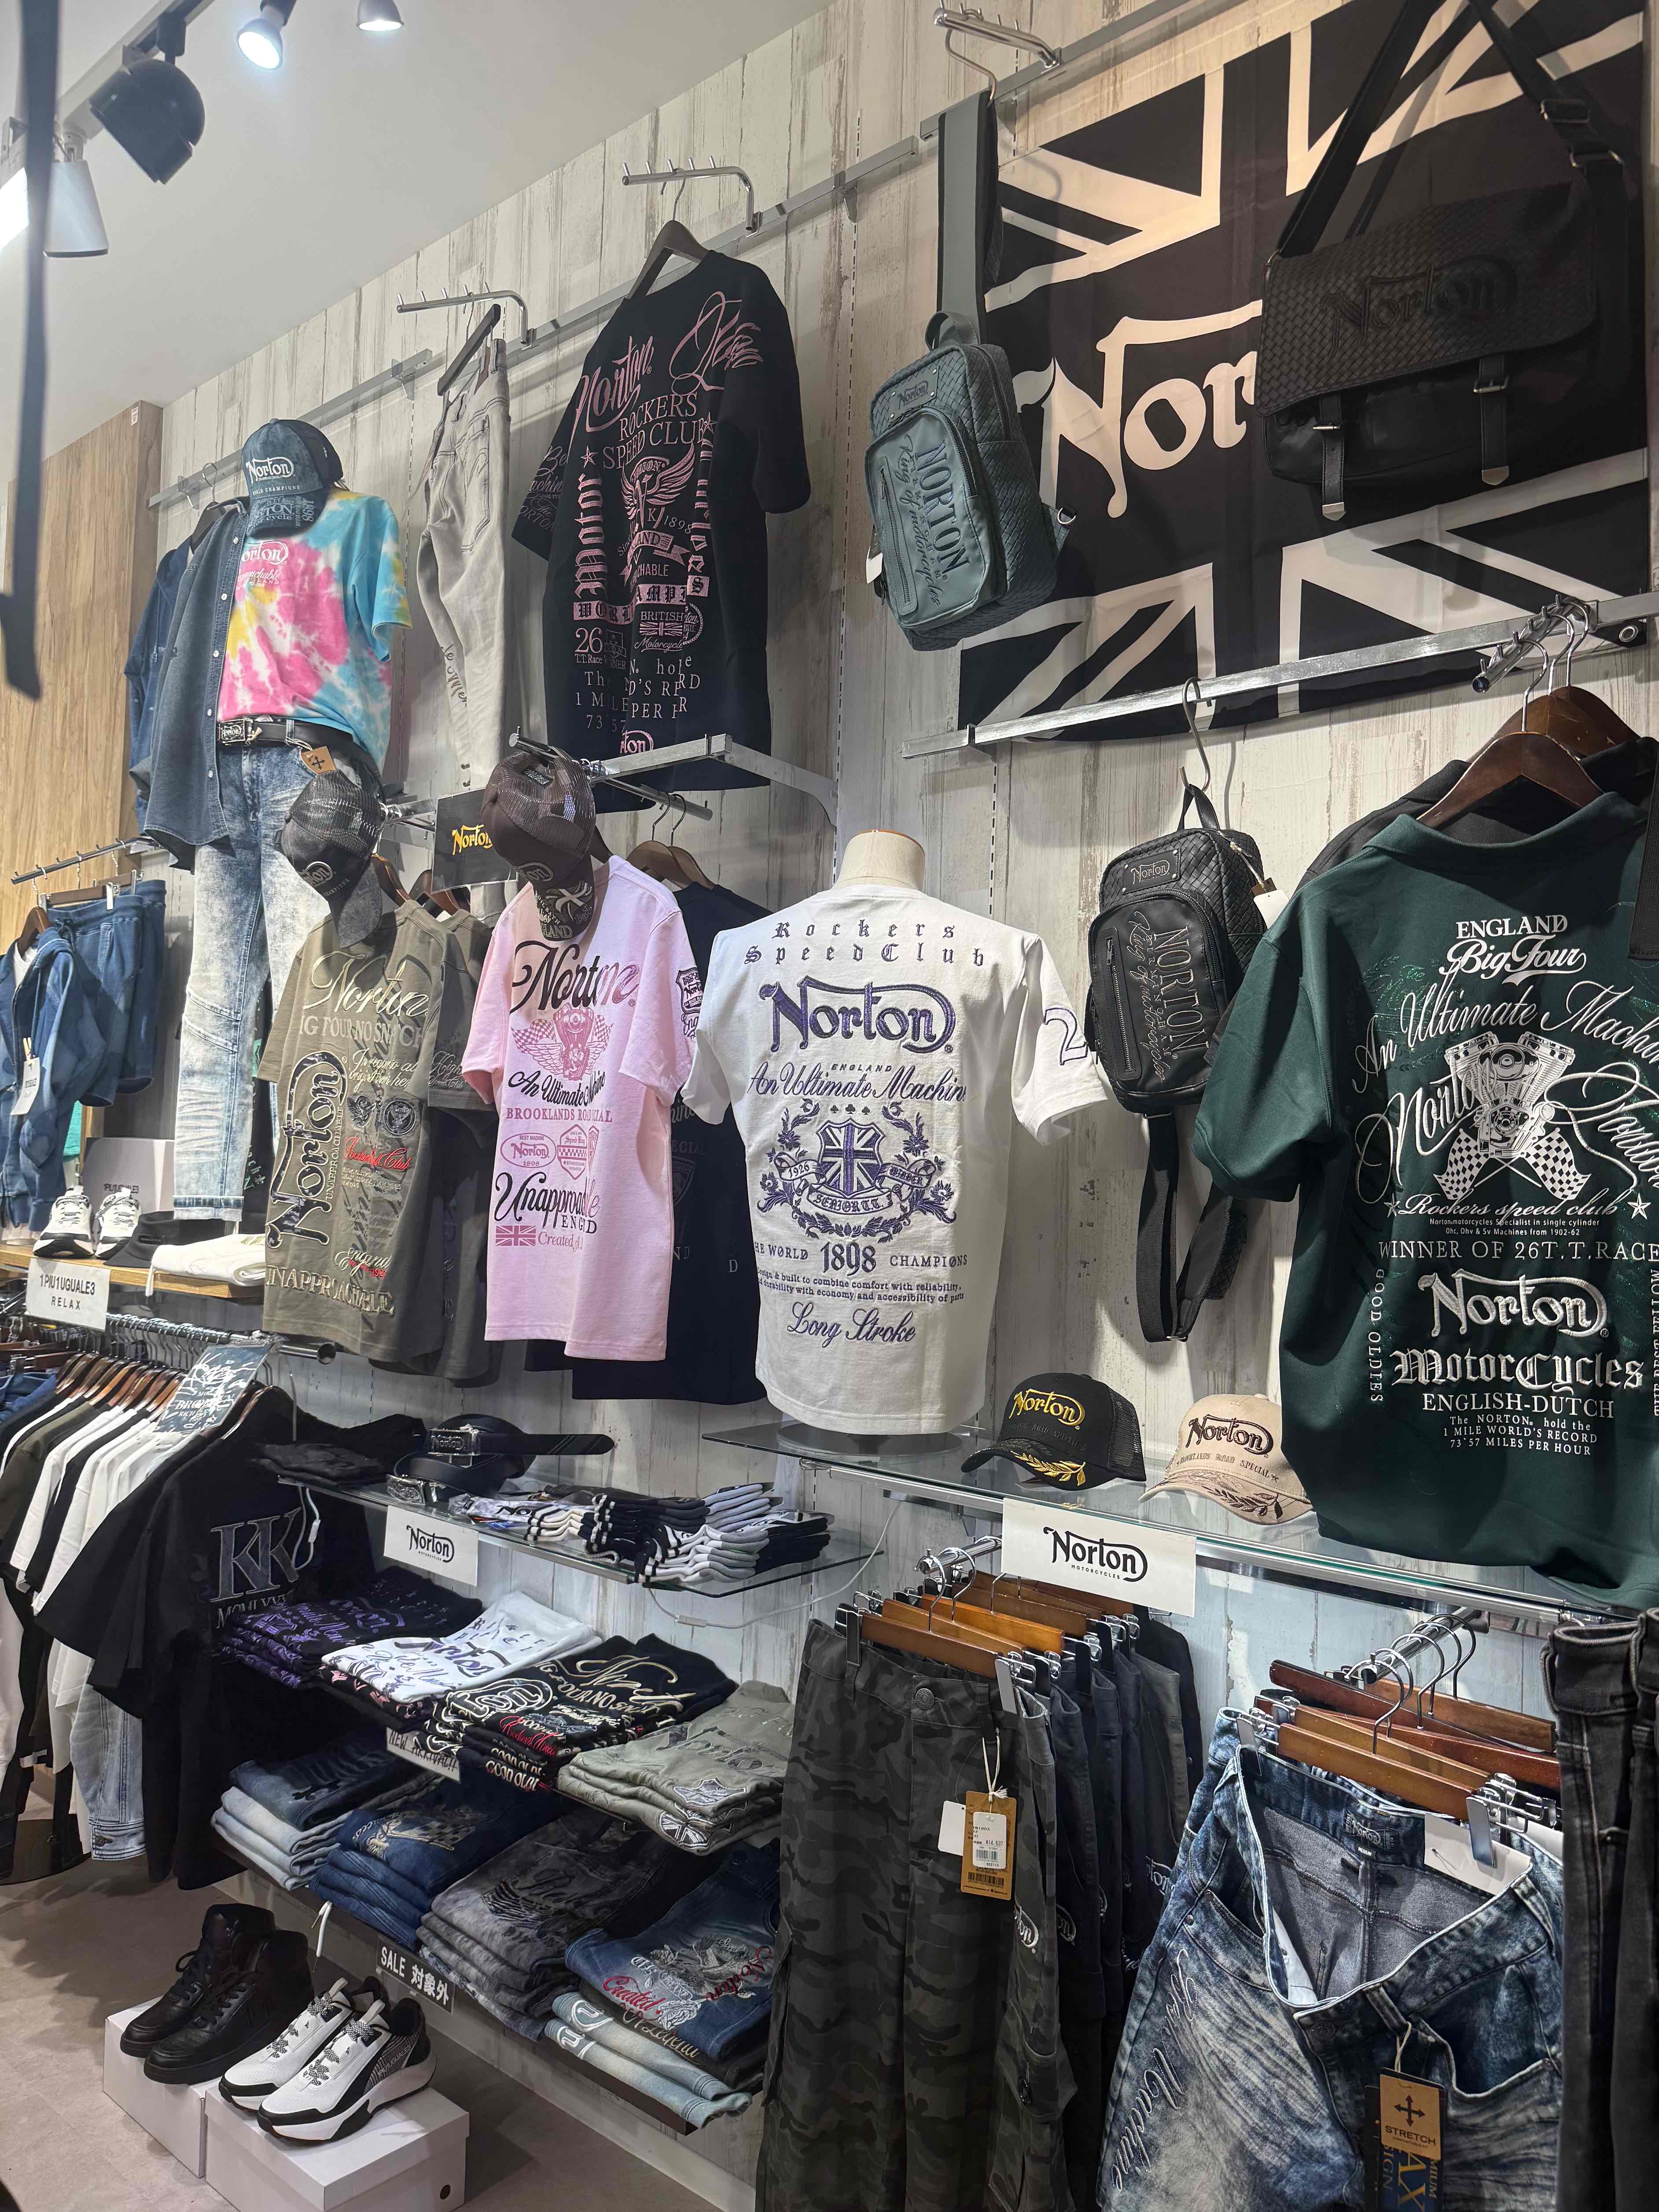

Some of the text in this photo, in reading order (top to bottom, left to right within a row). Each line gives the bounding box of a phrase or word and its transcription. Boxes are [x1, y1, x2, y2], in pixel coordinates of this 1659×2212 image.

[1322, 254, 1518, 355] Norton
[898, 379, 928, 410] Norton
[620, 393, 697, 441] ROCKERS
[1013, 299, 1263, 518] Nor
[603, 430, 645, 470] SPEED
[246, 457, 295, 484] Norton
[895, 434, 942, 607] King of motorcycles
[915, 440, 971, 576] NORTON
[242, 540, 289, 566] orton
[640, 610, 684, 622] BRITISH
[574, 627, 603, 654] 26
[1131, 859, 1171, 885] Norton
[772, 919, 955, 939] Rockers
[1456, 914, 1568, 940] ENGLAND
[744, 942, 985, 967] Speed Club
[1438, 934, 1587, 986] Big Four
[1126, 911, 1151, 963] King
[1139, 986, 1171, 1082] motorcycles
[1154, 926, 1209, 1051] NORTON
[758, 975, 956, 1054] Norton
[1400, 959, 1538, 1049] Ultimate
[321, 1016, 351, 1039] FOUR
[747, 1061, 780, 1096] An
[780, 1061, 874, 1098] Ultimate
[831, 1063, 893, 1073] ENGLAND
[508, 1070, 542, 1097] An
[506, 1107, 575, 1121] BROOKLANDS
[266, 1051, 349, 1250] Norton
[326, 1106, 344, 1201] UNAPPROACHABLE
[511, 1142, 549, 1159] Norton
[788, 1164, 810, 1179] 1926
[813, 1194, 861, 1213] SENIOR
[1397, 1187, 1633, 1225] Rockers speed club
[1543, 1219, 1566, 1227] single
[768, 1245, 809, 1261] WORLD
[820, 1241, 877, 1276] 1898
[890, 1253, 968, 1268] CHAMPIONS
[1379, 1240, 1505, 1260] WINNER OF
[39, 1274, 96, 1297] 1PIU1UGUALE3
[774, 1271, 780, 1279] &
[781, 1272, 800, 1283] built
[802, 1276, 810, 1284] to
[813, 1277, 850, 1288] combine
[851, 1281, 889, 1290] comfort
[891, 1282, 913, 1291] with
[51, 1296, 82, 1310] RELAX
[795, 1286, 815, 1296] with
[816, 1289, 854, 1300] economy
[857, 1291, 875, 1301] and
[877, 1292, 936, 1304] accessibility
[938, 1293, 949, 1303] of
[1417, 1268, 1608, 1338] Norton
[787, 1301, 917, 1349] Long Stroke
[1368, 1268, 1386, 1403] GOOD OLDIES
[1009, 1388, 1085, 1428] Norton
[1422, 1392, 1615, 1419] ENGLISH-DUTCH
[1185, 1413, 1274, 1456] Norton
[1450, 1415, 1469, 1426] The
[1543, 1417, 1566, 1430] hold
[1572, 1419, 1591, 1431] the
[1453, 1425, 1482, 1437] MILE
[1486, 1425, 1542, 1439] WORLD'S
[1547, 1429, 1598, 1444] RECORD
[1486, 1437, 1591, 1455] MILES PER HOUR
[1239, 1459, 1270, 1478] SPECIAL
[406, 1525, 455, 1563] Norton
[1043, 1526, 1149, 1583] Norton
[1071, 1564, 1121, 1580] MOTORCYCLES
[387, 1727, 408, 1752] NEW
[379, 1944, 407, 1979] SALE
[410, 1963, 451, 2006] 対象外
[1385, 2125, 1437, 2146] STRETCH
